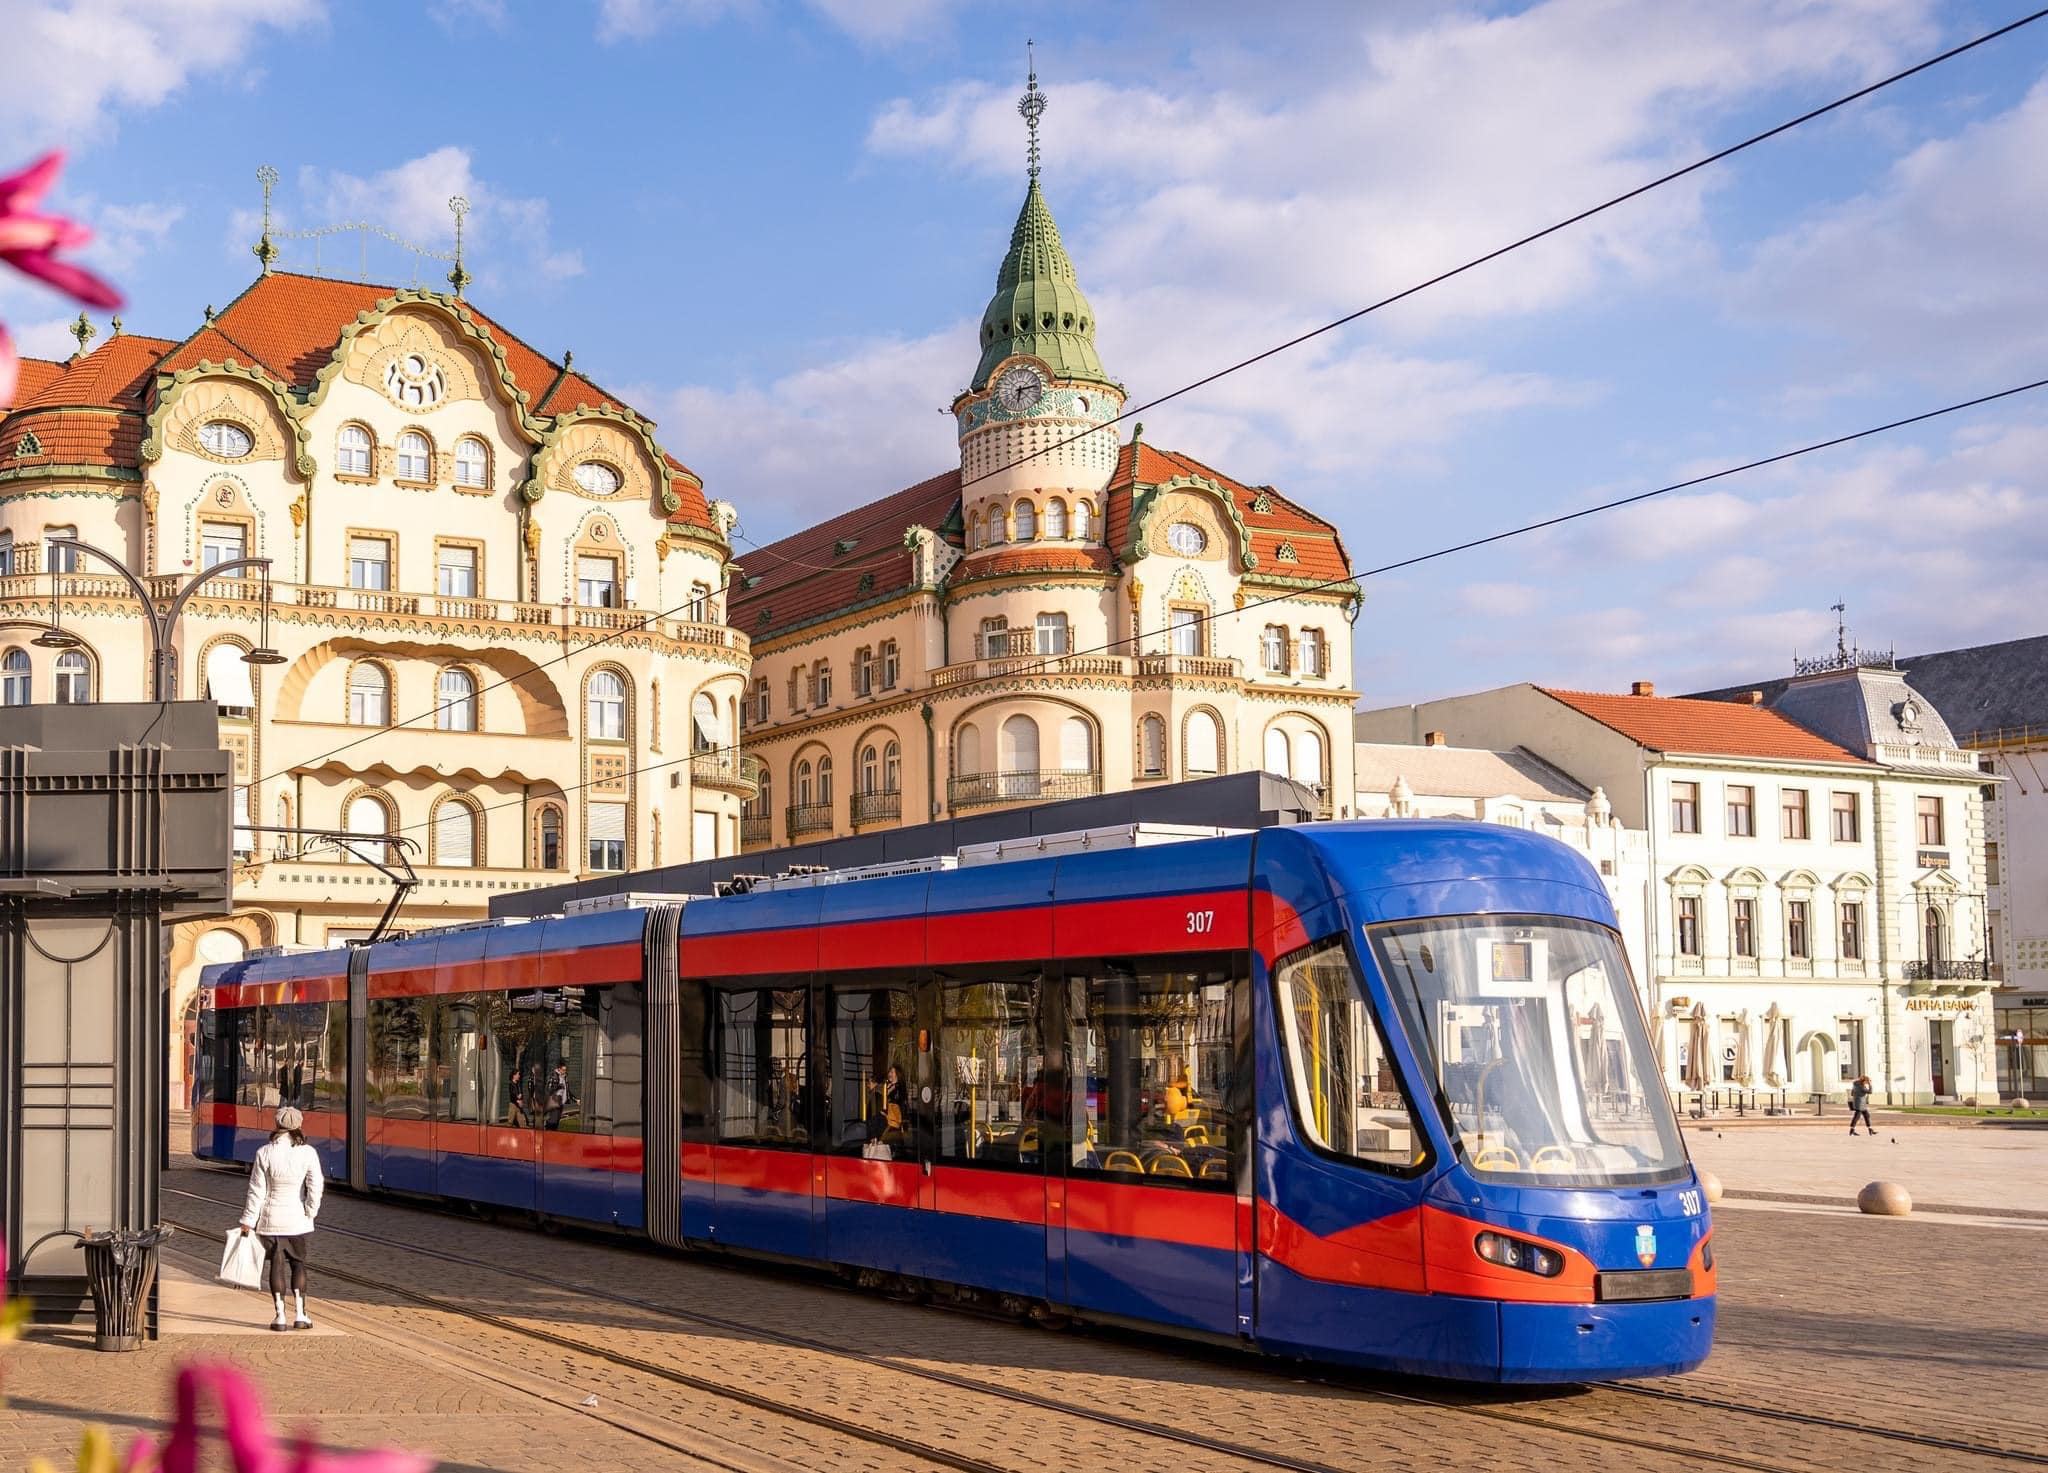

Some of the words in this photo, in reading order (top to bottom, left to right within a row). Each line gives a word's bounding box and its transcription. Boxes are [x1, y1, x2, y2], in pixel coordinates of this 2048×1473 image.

[1186, 911, 1214, 933] 307
[1905, 999, 1941, 1011] ALPHA
[1942, 1000, 1974, 1012] BANK
[1678, 1190, 1701, 1217] 307
